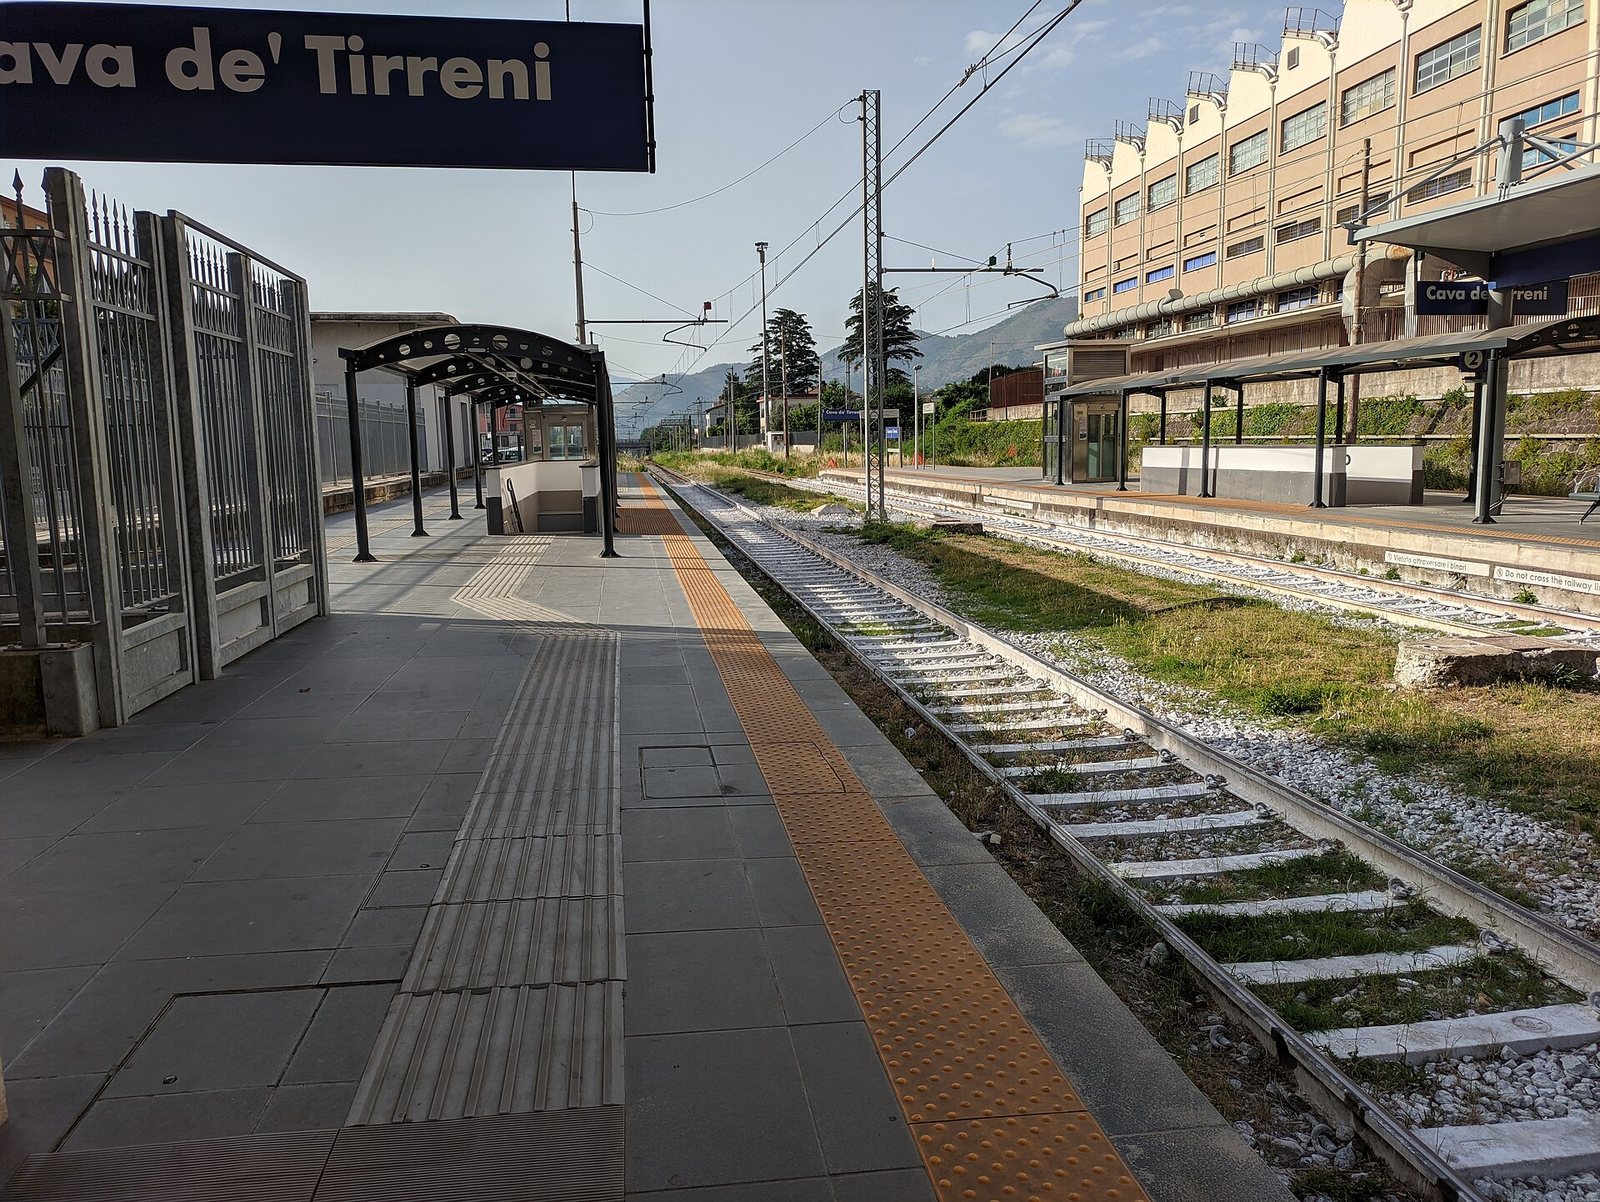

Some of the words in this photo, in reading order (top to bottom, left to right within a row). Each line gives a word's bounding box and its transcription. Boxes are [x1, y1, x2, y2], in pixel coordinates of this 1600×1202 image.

[165, 27, 282, 93] de'
[305, 35, 552, 101] Tirreni
[1426, 285, 1466, 300] Cava
[1512, 286, 1548, 301] rreni
[1468, 352, 1479, 366] 2
[1450, 562, 1467, 571] binari
[1505, 569, 1514, 578] Do
[1516, 572, 1528, 580] not
[1529, 574, 1549, 583] cross
[1551, 576, 1563, 585] the
[1564, 579, 1592, 591] railway
